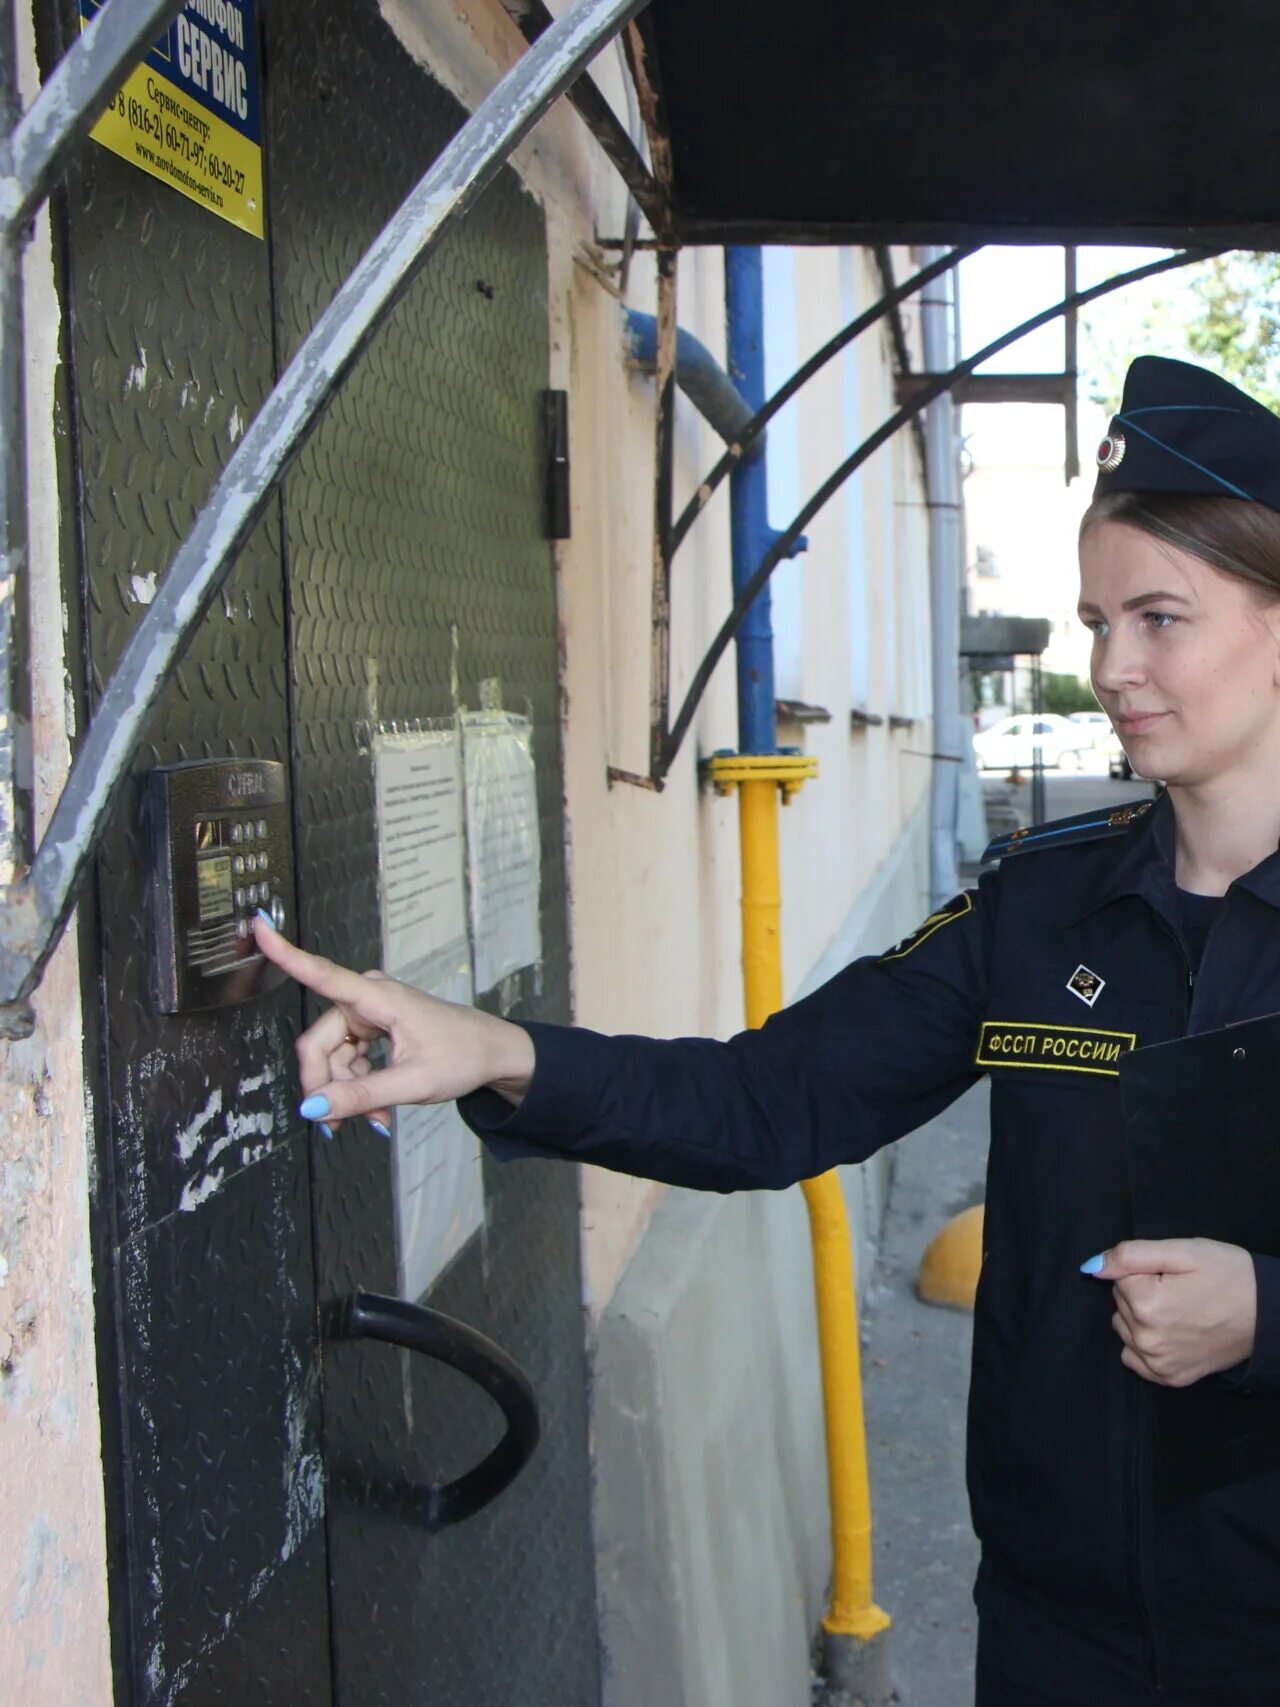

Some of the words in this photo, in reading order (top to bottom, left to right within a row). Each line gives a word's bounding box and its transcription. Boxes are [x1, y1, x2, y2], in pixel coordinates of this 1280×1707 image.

[184, 0, 244, 51] ОФОН
[178, 13, 248, 120] СЕРВИС
[118, 91, 125, 117] 8
[129, 96, 163, 150] (816-2)
[166, 123, 208, 177] 60-71-97;
[208, 153, 246, 196] 60-20-27
[147, 77, 211, 144] Сервис-центр:
[988, 1034, 1037, 1055] ФССП
[1041, 1038, 1121, 1062] РОССИИ
